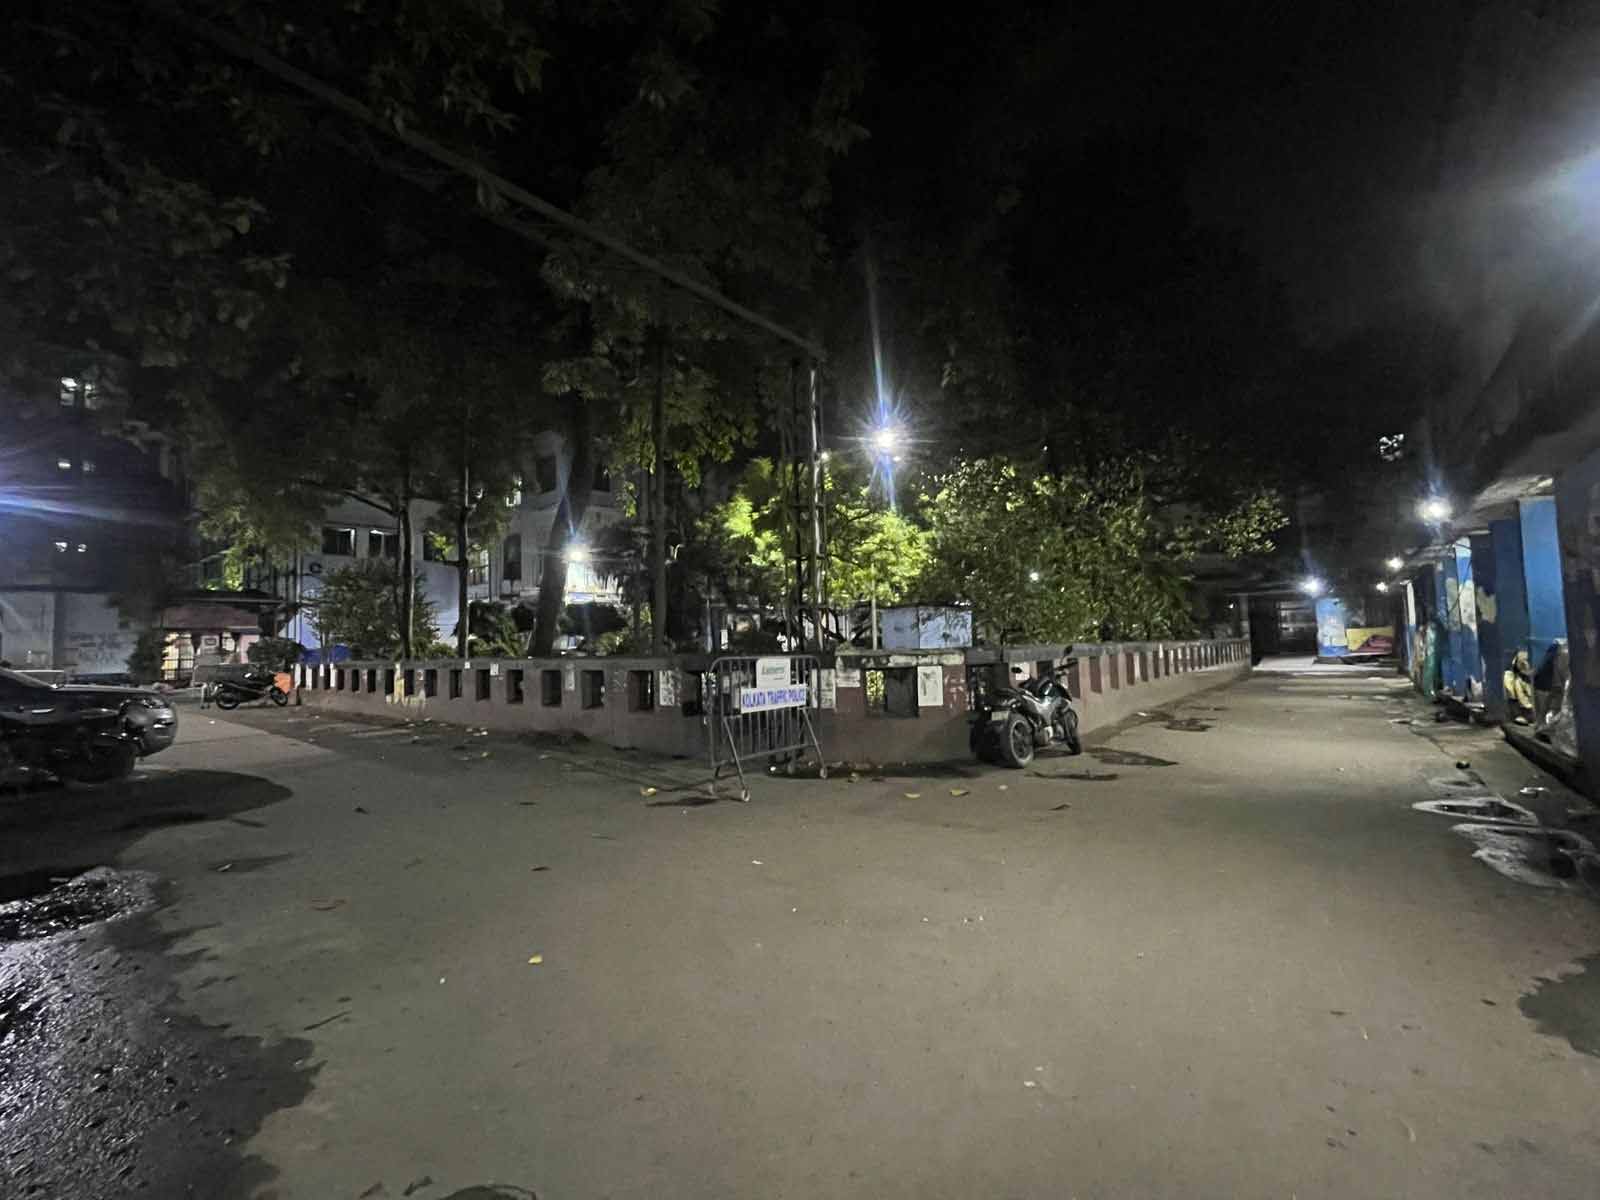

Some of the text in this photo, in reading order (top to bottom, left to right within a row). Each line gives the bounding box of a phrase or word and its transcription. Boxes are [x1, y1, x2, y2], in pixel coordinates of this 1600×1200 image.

[742, 691, 766, 707] KOLKATA
[767, 689, 788, 705] TRAFFIC
[788, 688, 805, 702] POLICE
